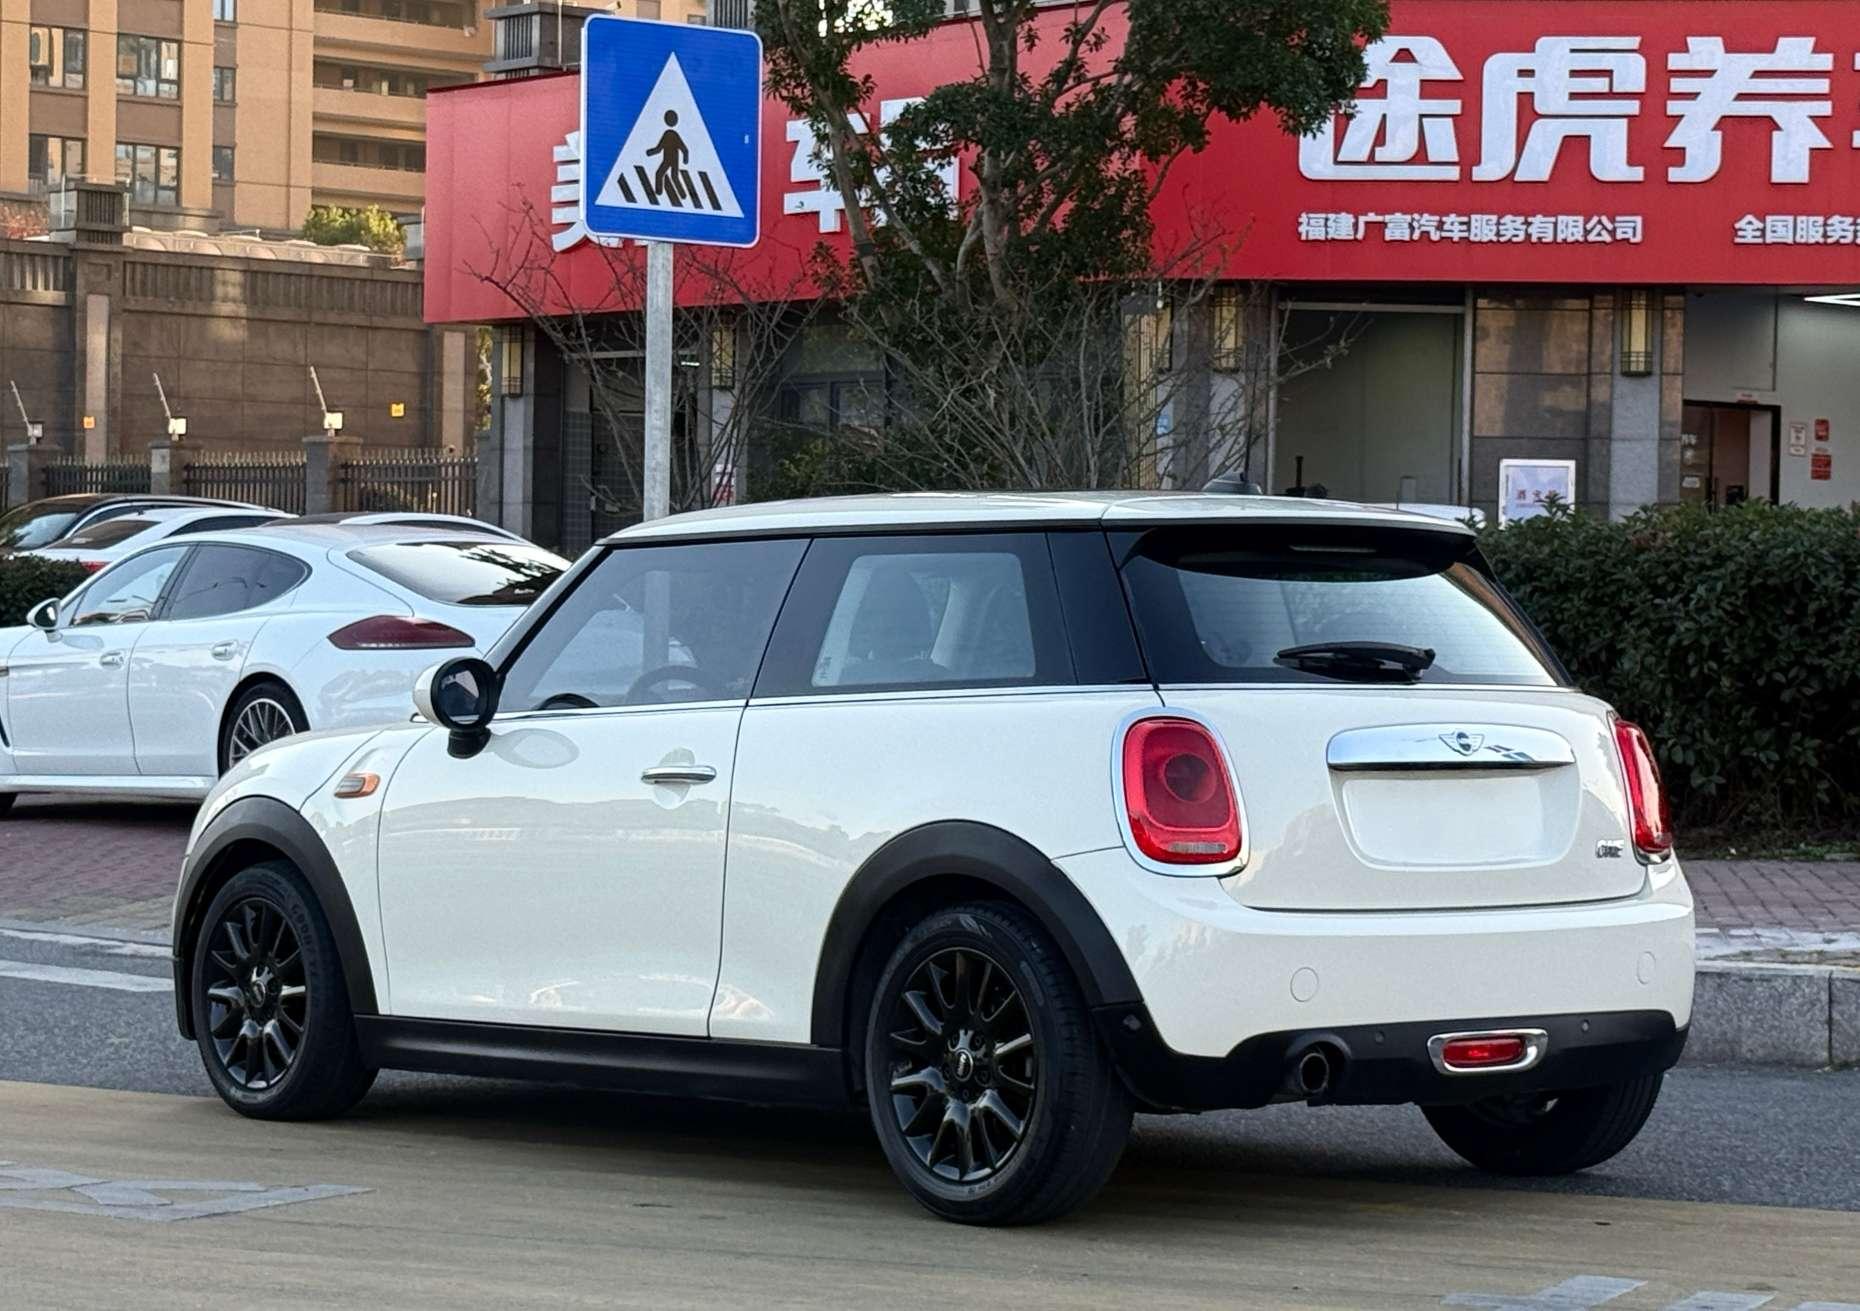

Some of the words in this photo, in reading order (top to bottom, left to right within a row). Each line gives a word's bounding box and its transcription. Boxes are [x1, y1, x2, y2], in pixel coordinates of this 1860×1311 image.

[1298, 36, 1860, 183] 途虎养
[1298, 211, 1643, 244] 福建广富汽车服务有限公司
[1733, 213, 1860, 245] 全国服务
